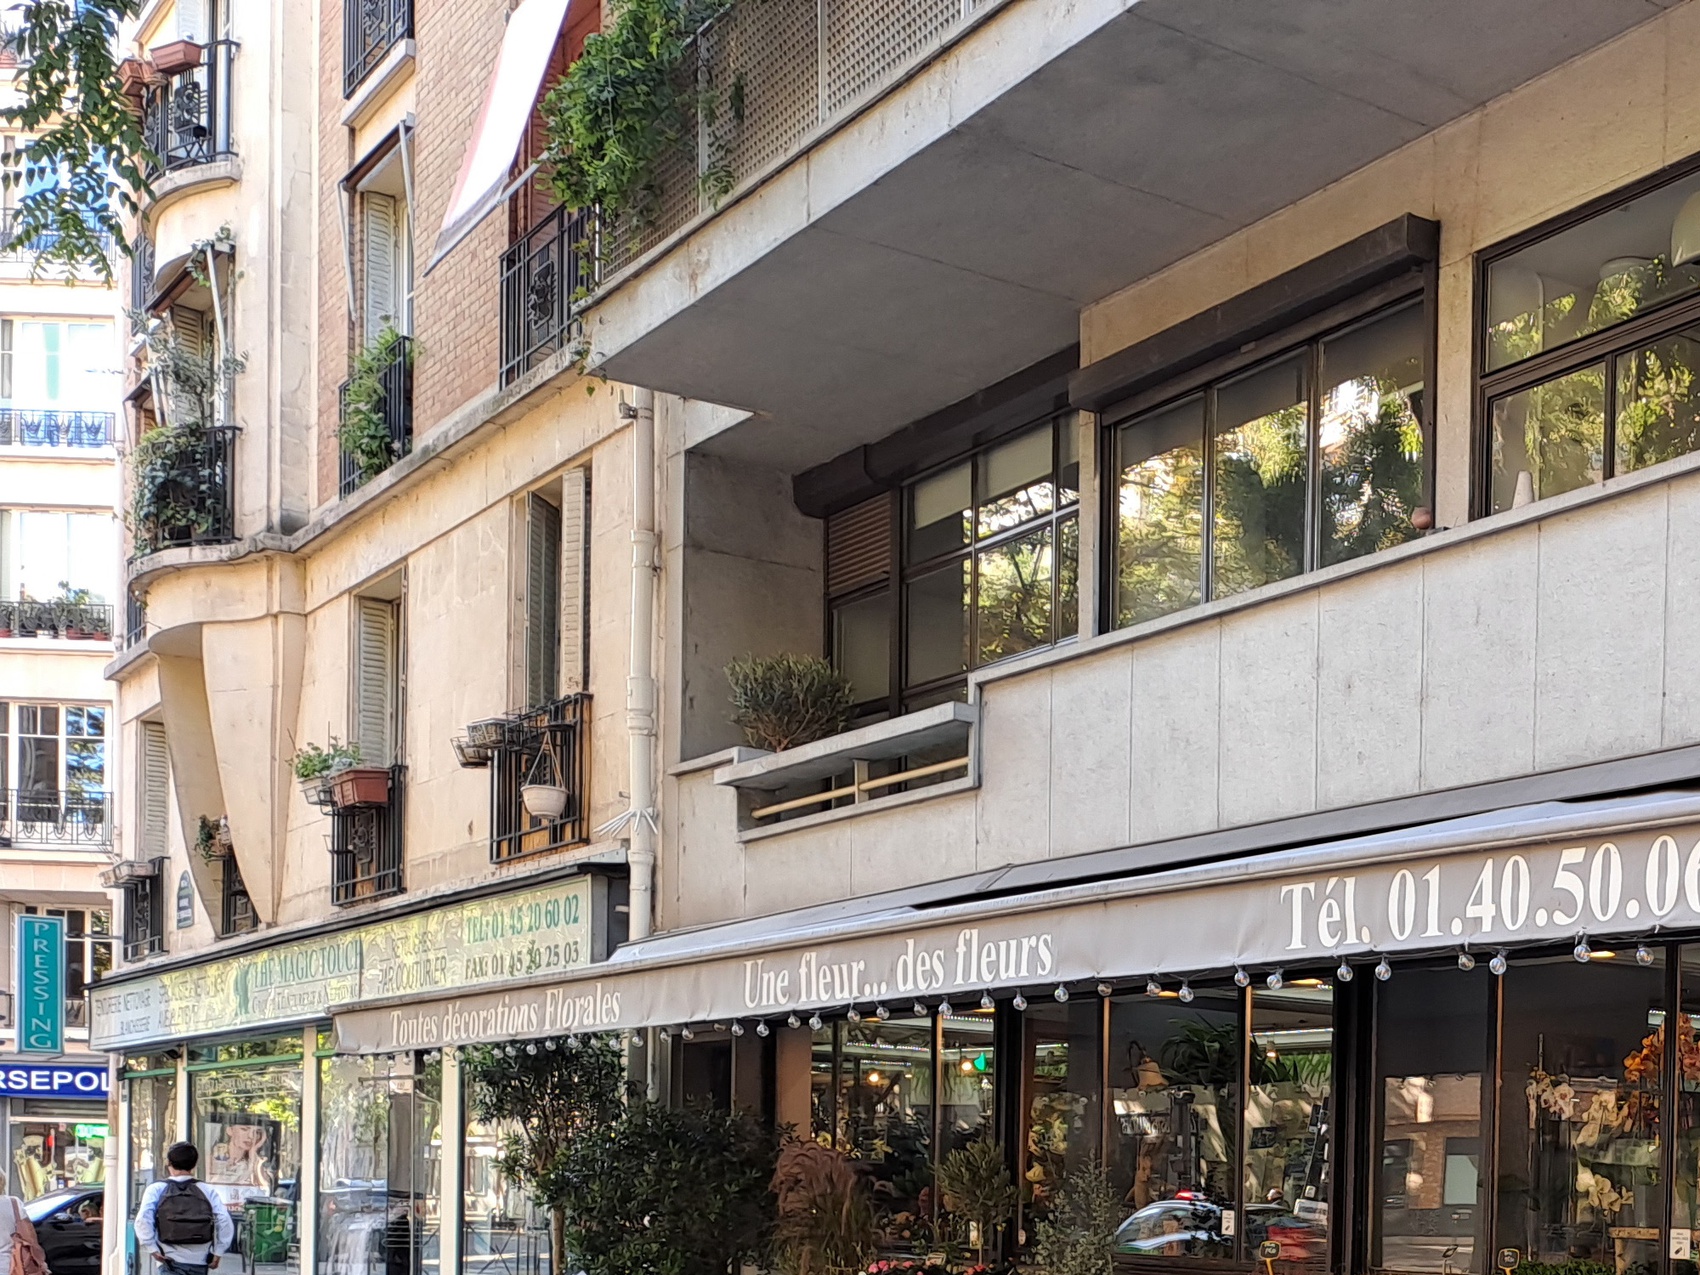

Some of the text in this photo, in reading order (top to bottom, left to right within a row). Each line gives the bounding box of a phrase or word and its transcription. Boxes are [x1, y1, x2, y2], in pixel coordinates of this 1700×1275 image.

[491, 910, 505, 939] 01
[509, 904, 523, 935] 45
[527, 902, 541, 933] 20
[545, 898, 560, 929] 60
[564, 894, 579, 925] 02
[1280, 876, 1371, 950] Tél.
[29, 922, 52, 1048] PRESSING
[253, 958, 276, 988] THE
[279, 949, 318, 983] MAGIC
[319, 940, 364, 976] TOUCH
[465, 957, 489, 980] FAX:
[491, 953, 505, 976] 01
[545, 944, 560, 967] 25
[563, 941, 579, 965] 03
[743, 929, 1052, 1009] Une fleur... des fleurs
[390, 983, 621, 1047] Toutes décorations Florales
